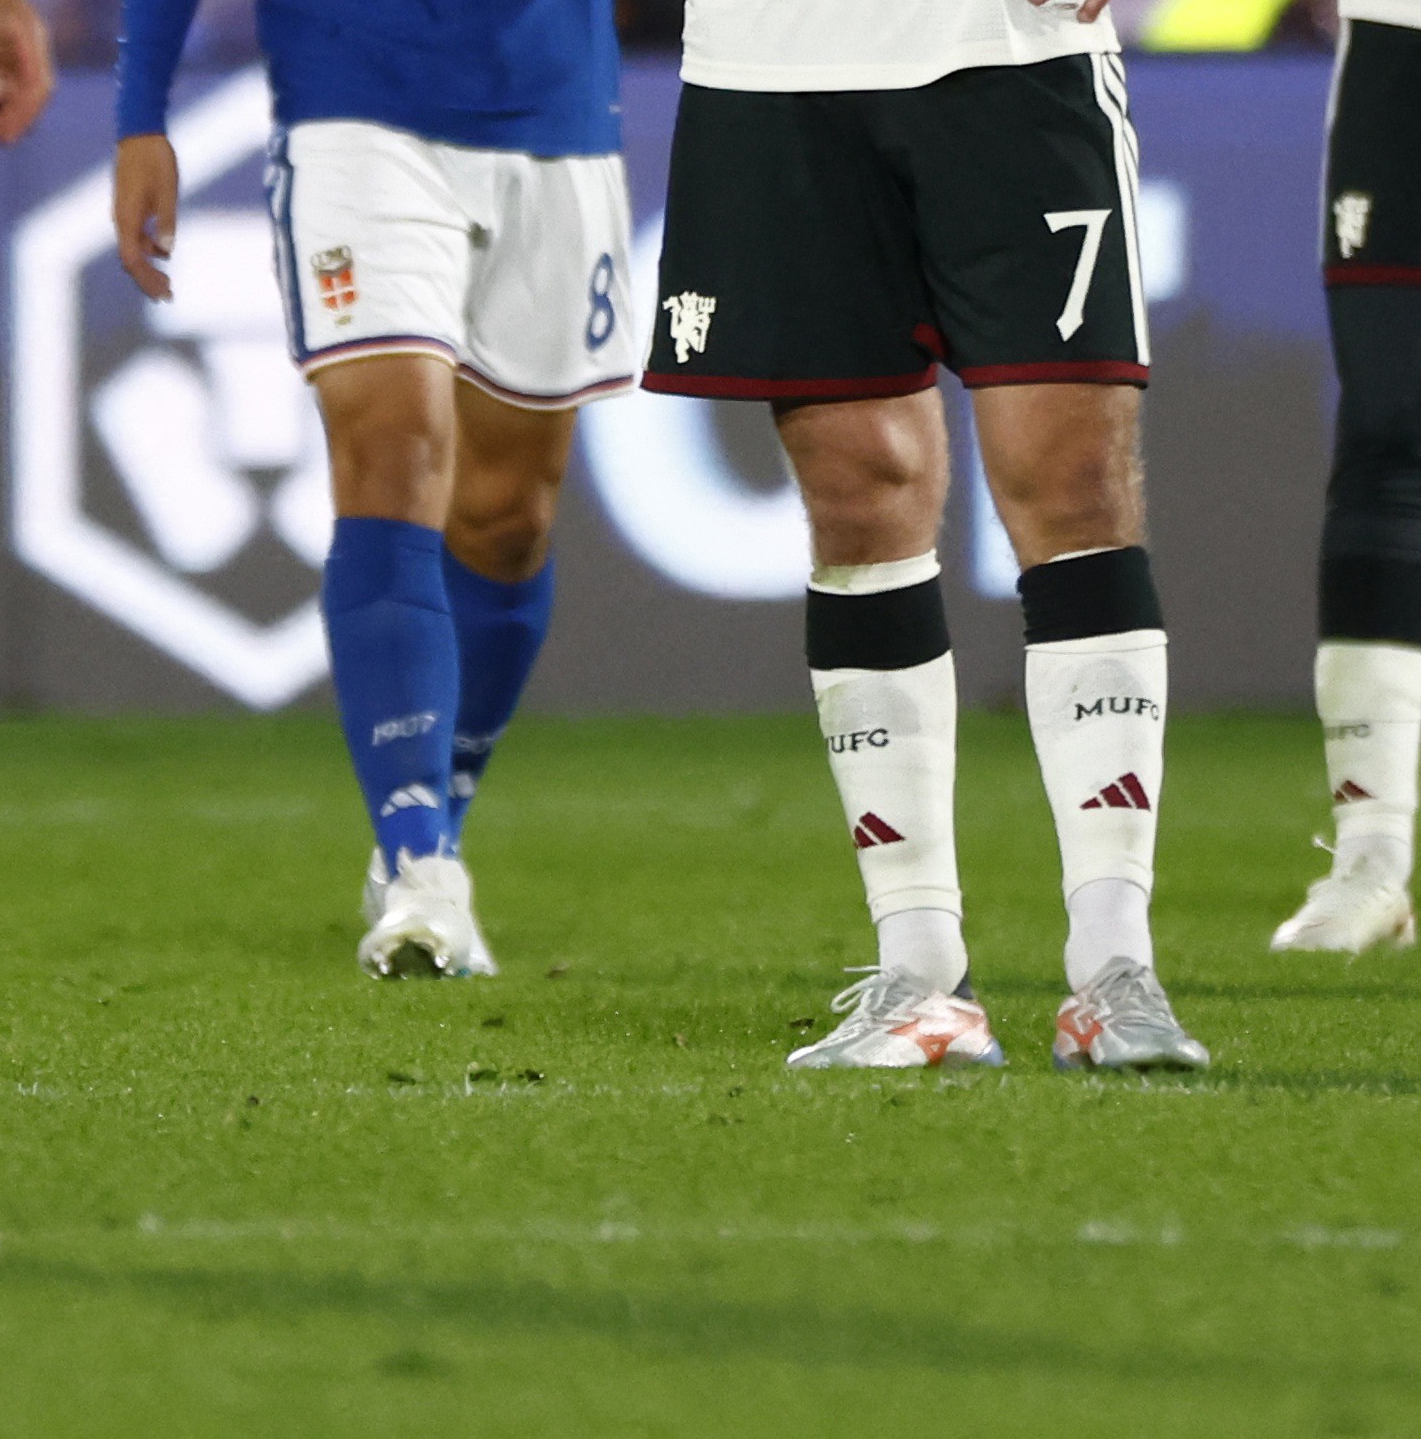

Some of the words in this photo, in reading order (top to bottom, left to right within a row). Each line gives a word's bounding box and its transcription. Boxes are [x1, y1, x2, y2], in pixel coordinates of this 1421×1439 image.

[584, 251, 616, 352] 8
[1042, 208, 1113, 343] 7
[829, 727, 890, 754] UFC
[1073, 696, 1160, 722] MUFC
